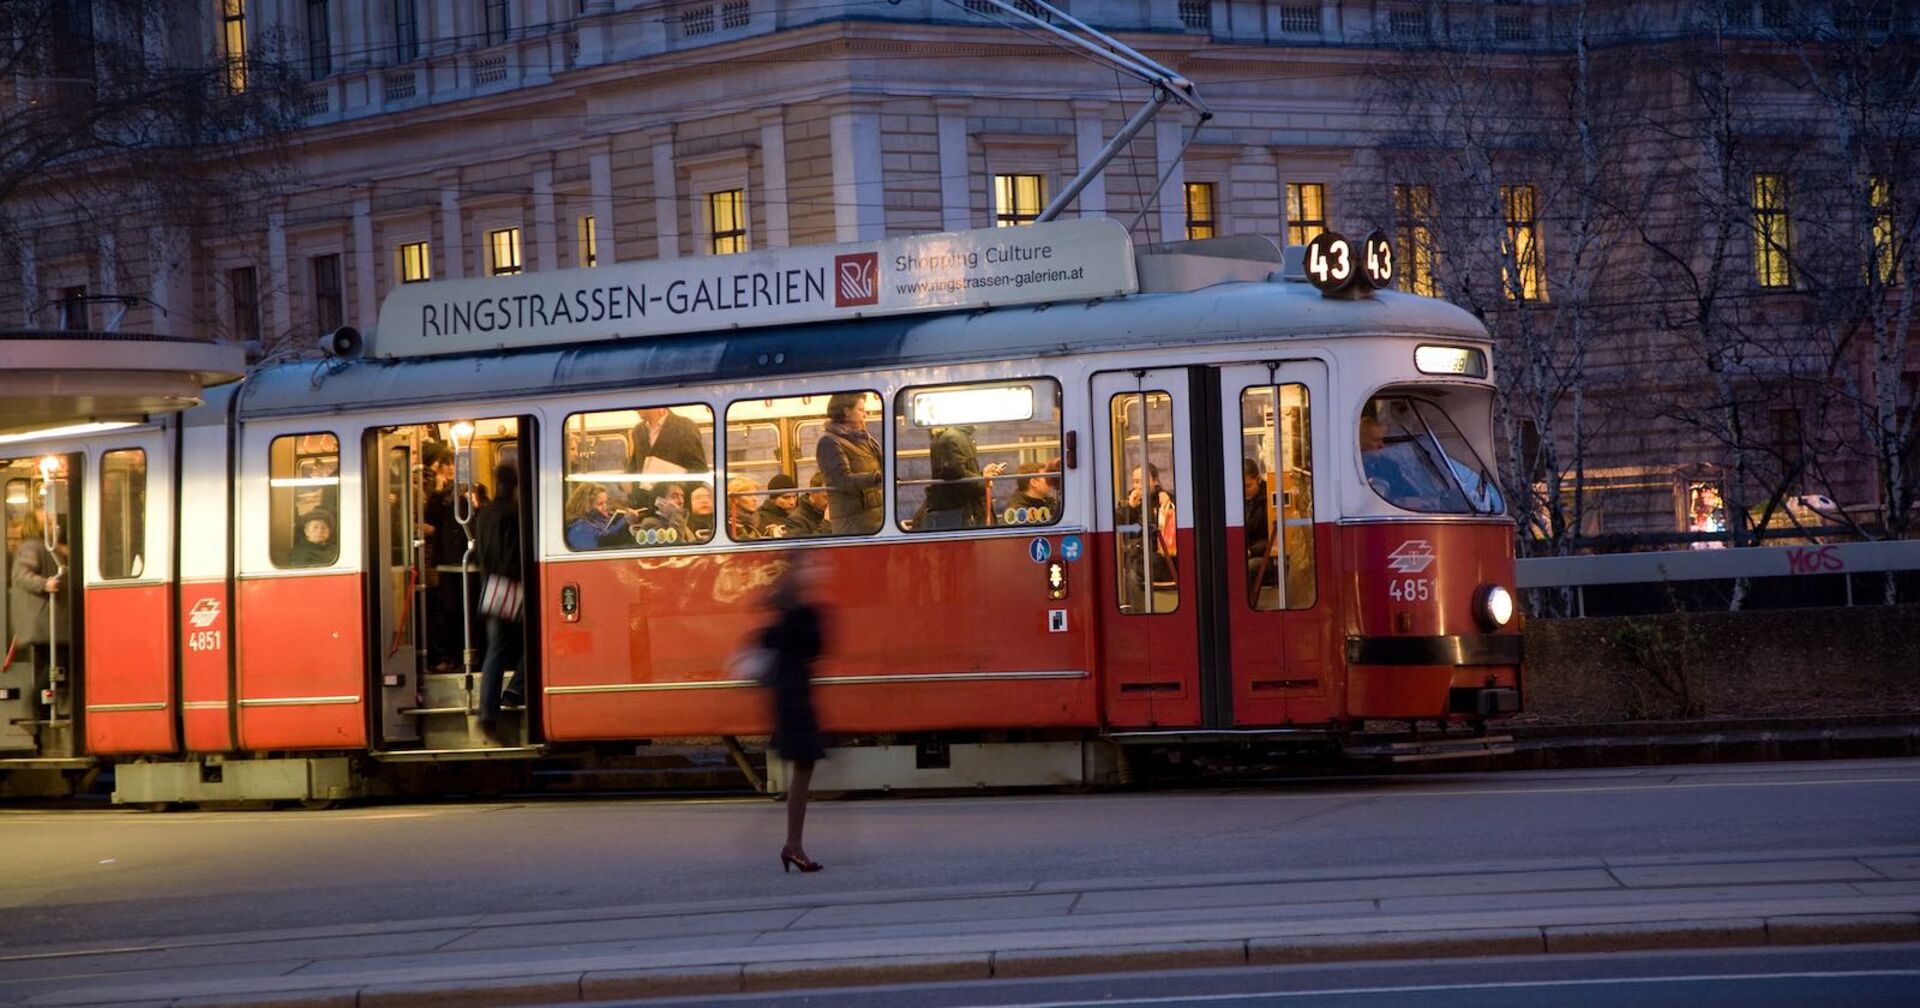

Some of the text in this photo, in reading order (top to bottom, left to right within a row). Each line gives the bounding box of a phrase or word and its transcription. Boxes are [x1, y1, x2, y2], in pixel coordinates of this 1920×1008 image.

[895, 246, 1052, 272] Shopping Culture
[1310, 240, 1350, 282] 43
[1367, 240, 1392, 280] 43
[896, 265, 1084, 295] www.ringstrassen-galerien.at
[422, 267, 826, 337] RINGSTRASSEN-GALERIEN
[1389, 577, 1440, 602] 4851
[188, 630, 221, 652] 4851
